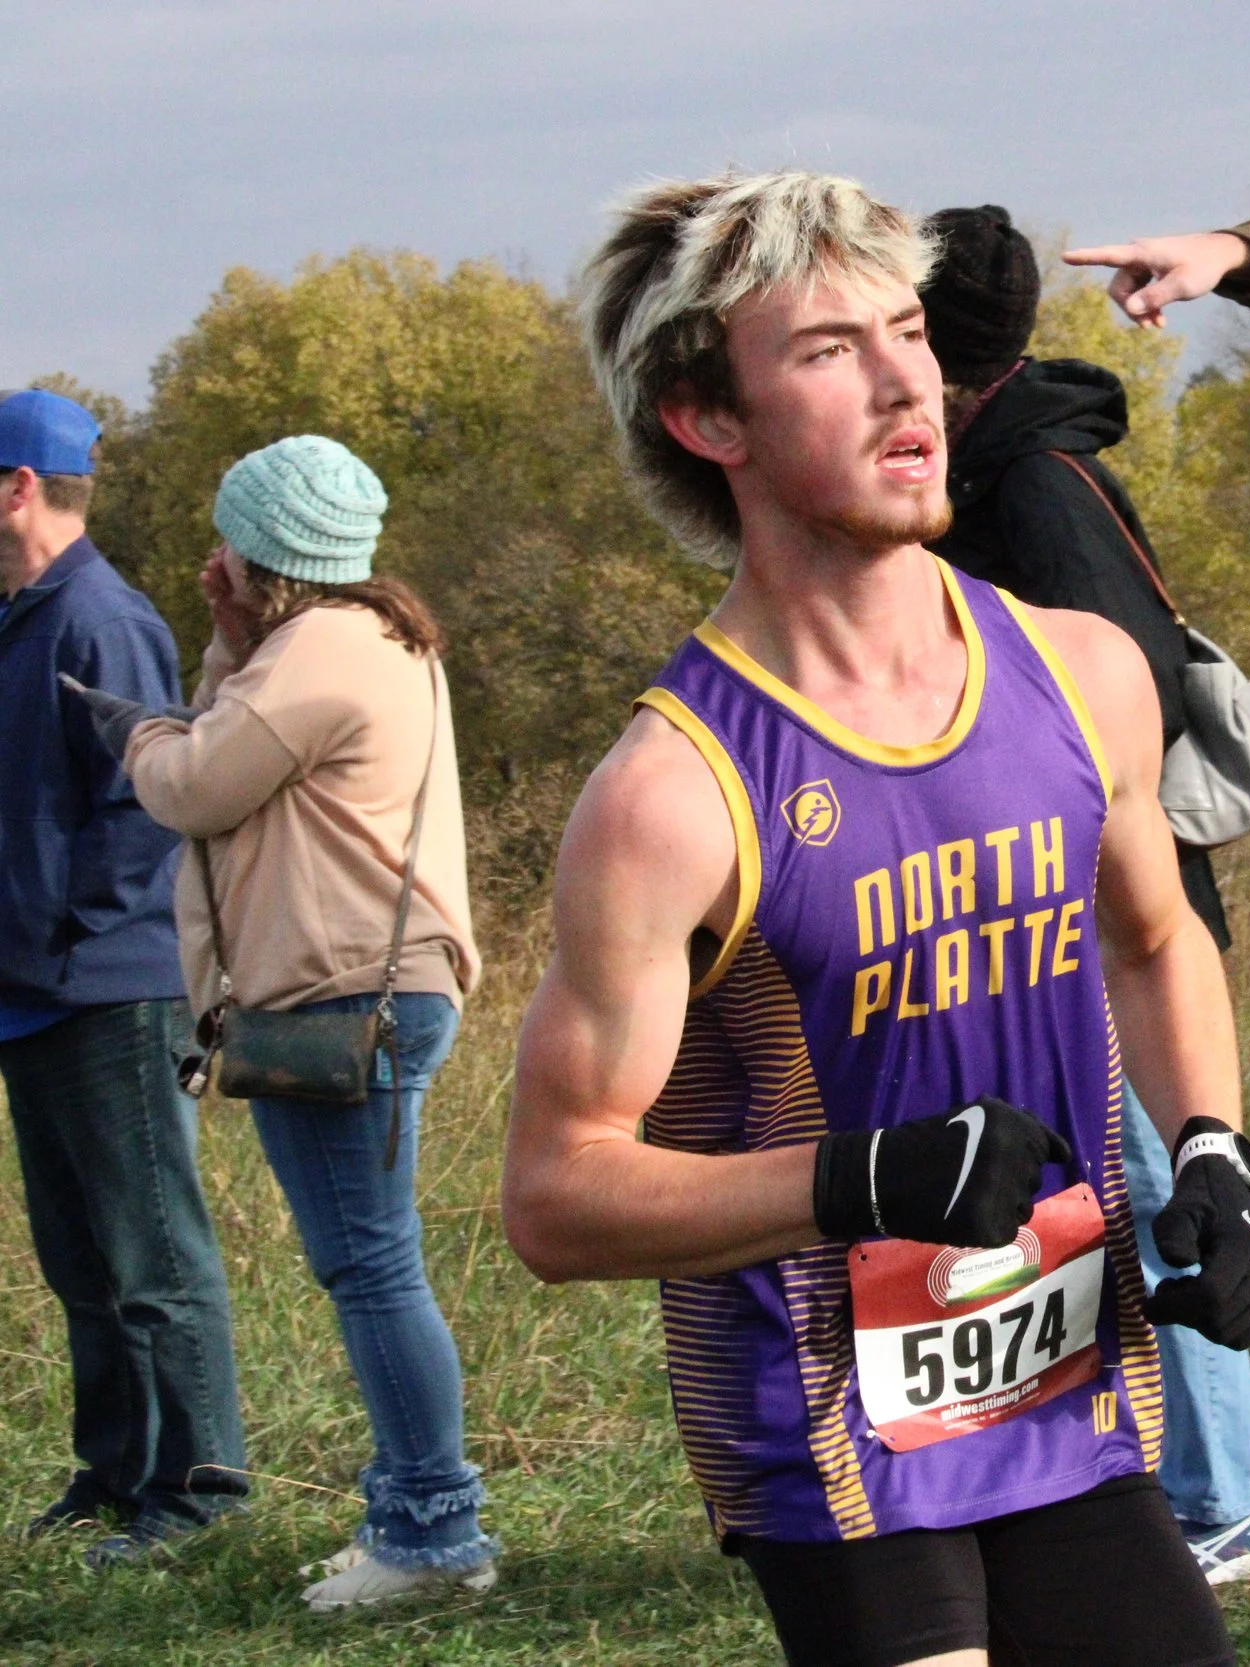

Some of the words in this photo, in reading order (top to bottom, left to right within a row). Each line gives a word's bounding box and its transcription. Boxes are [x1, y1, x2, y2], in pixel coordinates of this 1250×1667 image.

[854, 816, 1066, 956] NORTH
[851, 898, 1084, 1037] PLATTE
[902, 1287, 1067, 1407] 5974
[940, 1378, 1039, 1422] midwesttiming.com
[1091, 1391, 1118, 1436] 10
